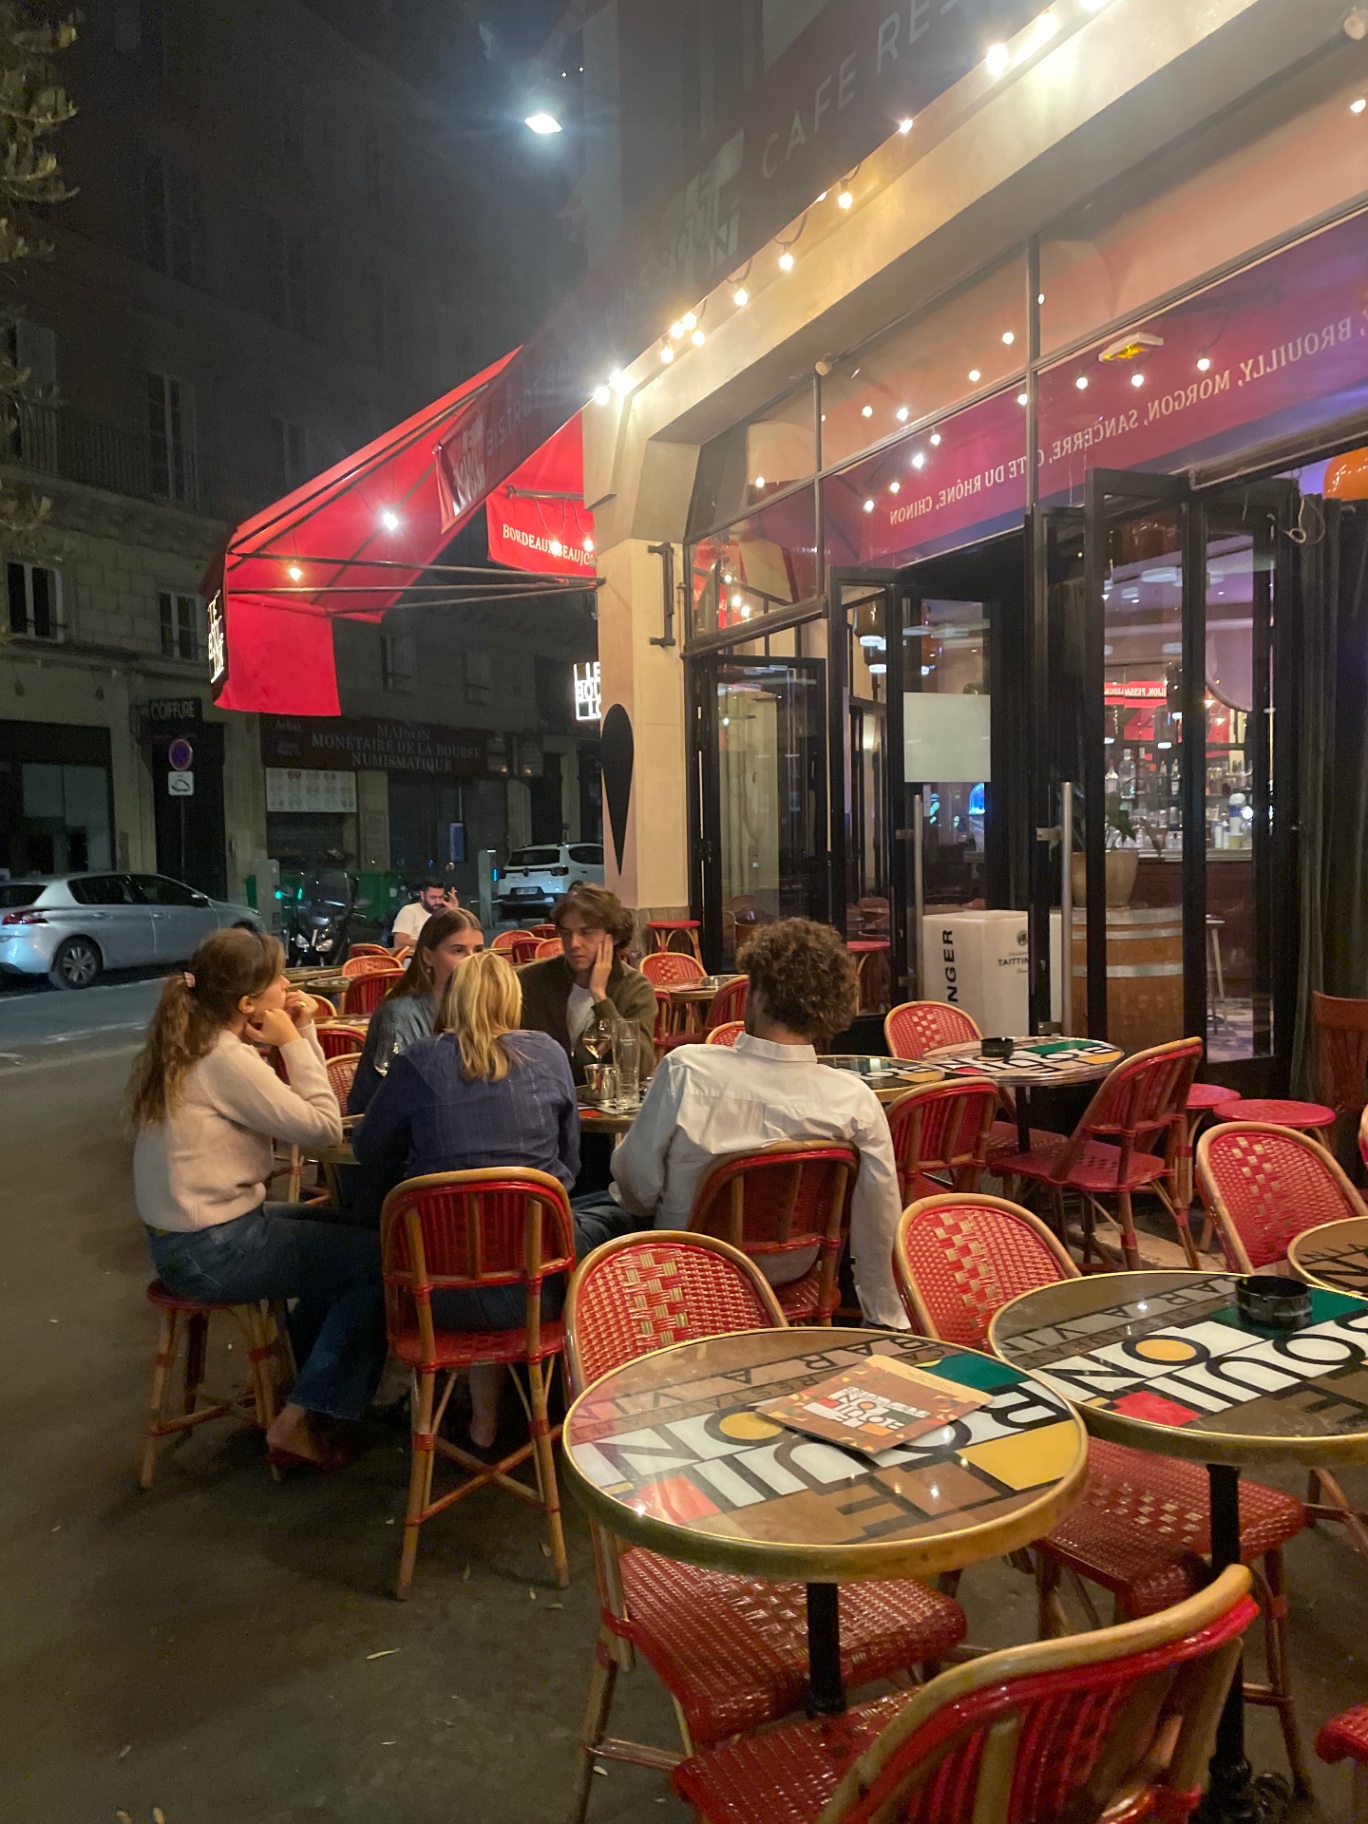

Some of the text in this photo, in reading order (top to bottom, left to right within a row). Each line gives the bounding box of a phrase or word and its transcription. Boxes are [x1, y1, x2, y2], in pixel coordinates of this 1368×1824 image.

[763, 0, 957, 178] CAFE RE
[557, 543, 594, 566] EAUJO
[377, 724, 430, 741] MAISON
[397, 740, 414, 754] DE
[417, 742, 433, 756] LA
[436, 744, 482, 760] BOURSE
[352, 752, 453, 774] NUMISMATIQUE
[1157, 1277, 1236, 1306] AR
[804, 1336, 932, 1371] BAR
[718, 1369, 752, 1385] A
